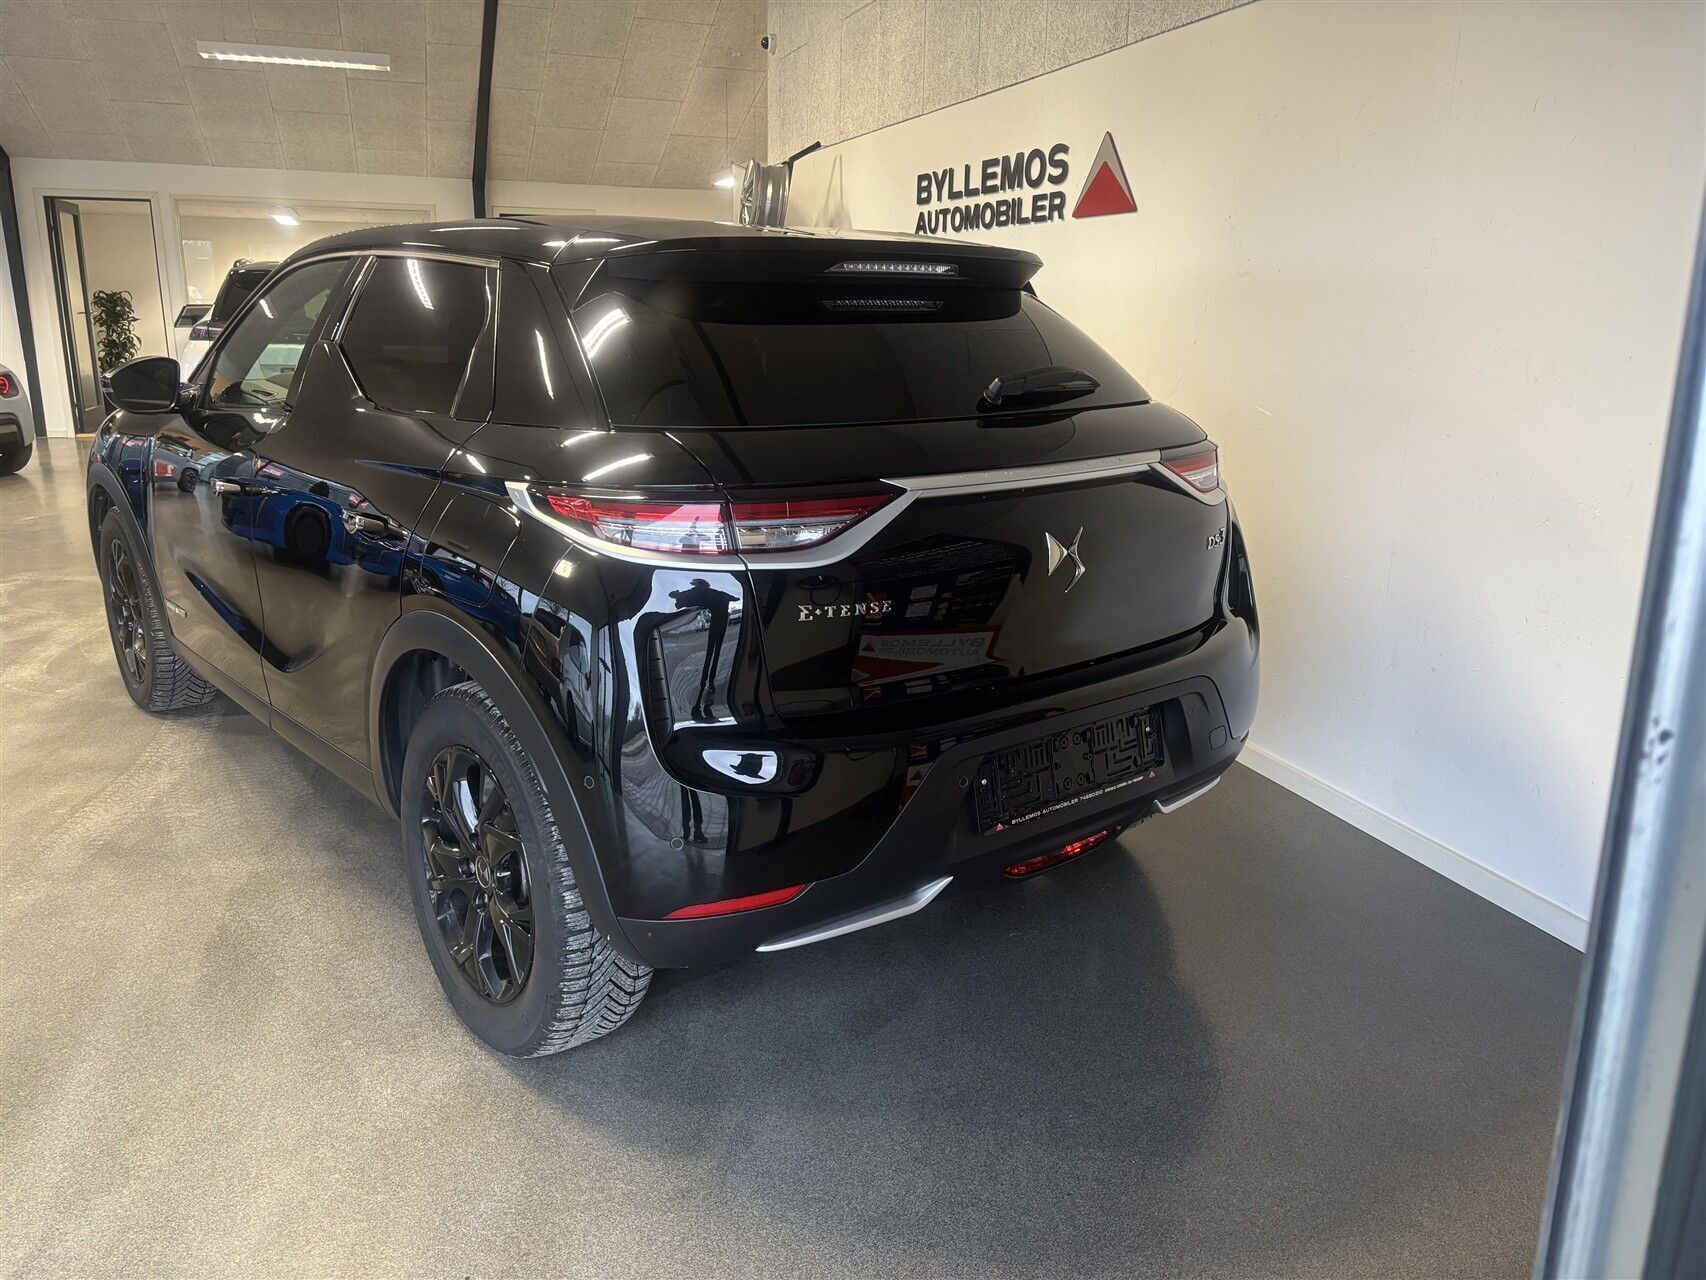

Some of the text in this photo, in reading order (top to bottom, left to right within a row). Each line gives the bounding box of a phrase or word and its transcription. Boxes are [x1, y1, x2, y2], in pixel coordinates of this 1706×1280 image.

[917, 143, 1070, 205] BYLLEMOS
[915, 191, 1066, 235] AUTOMOBILER
[1011, 811, 1041, 825] BYLLEMOS
